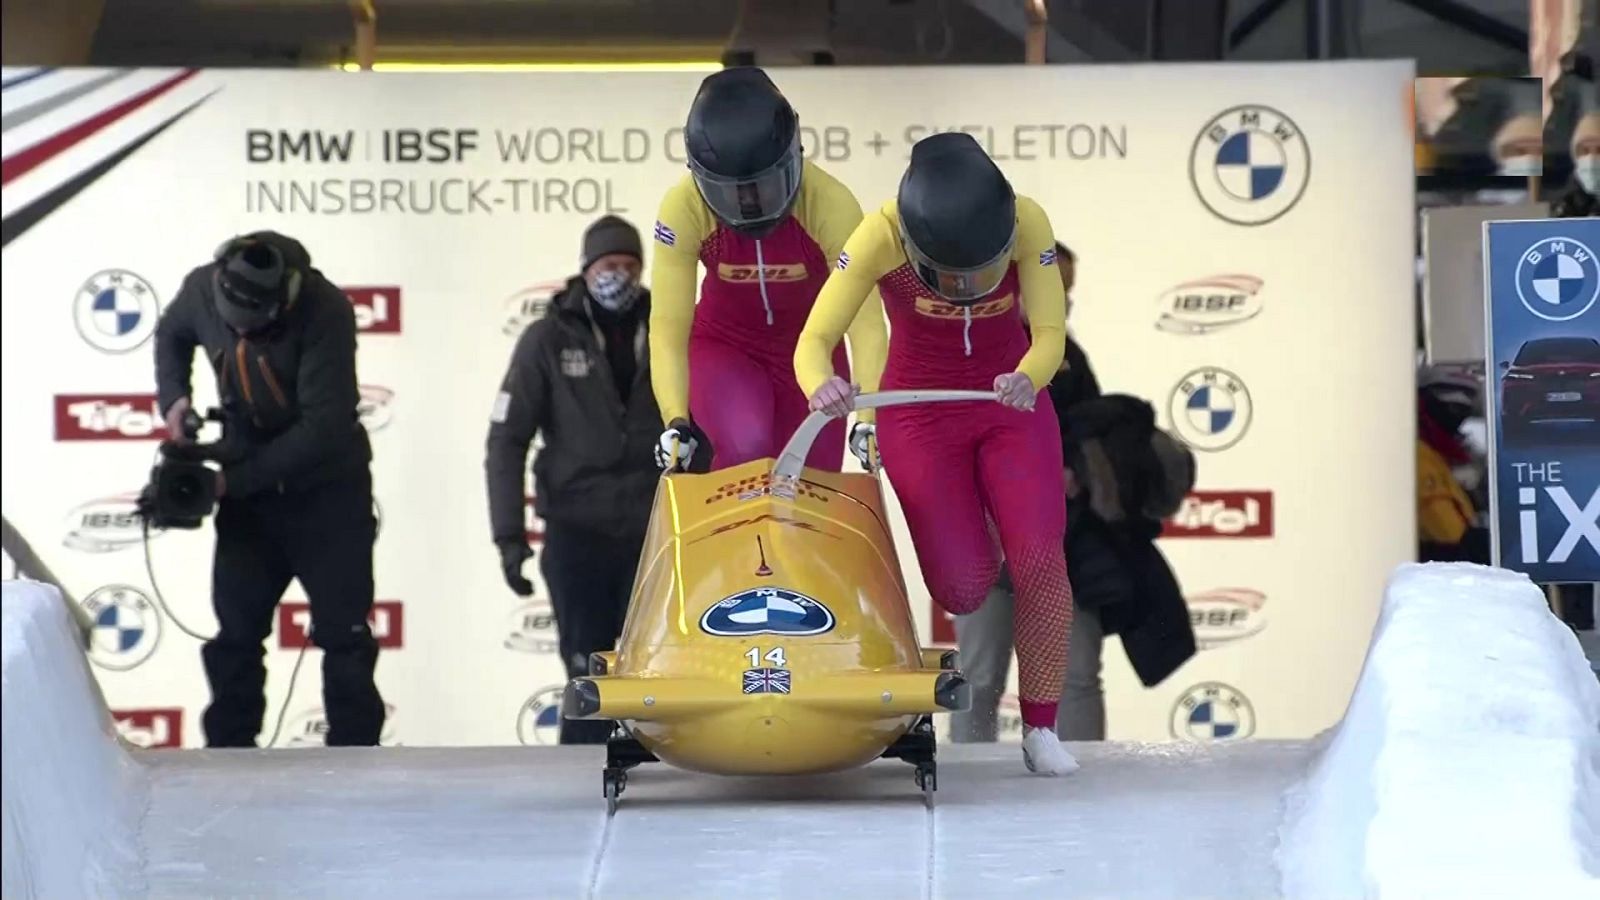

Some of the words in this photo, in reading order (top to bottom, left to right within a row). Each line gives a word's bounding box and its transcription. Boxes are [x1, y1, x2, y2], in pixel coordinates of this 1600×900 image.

[1207, 109, 1297, 143] BMW
[245, 128, 355, 164] BMW
[382, 128, 480, 164] IBSF
[494, 127, 651, 164] WORLD
[799, 126, 852, 162] OB
[246, 177, 630, 215] INNSBRUCK-TIROL
[1526, 241, 1591, 266] BMW
[1510, 461, 1563, 483] THE
[1518, 485, 1600, 564] iX
[718, 589, 816, 609] BMW
[744, 646, 788, 668] 14
